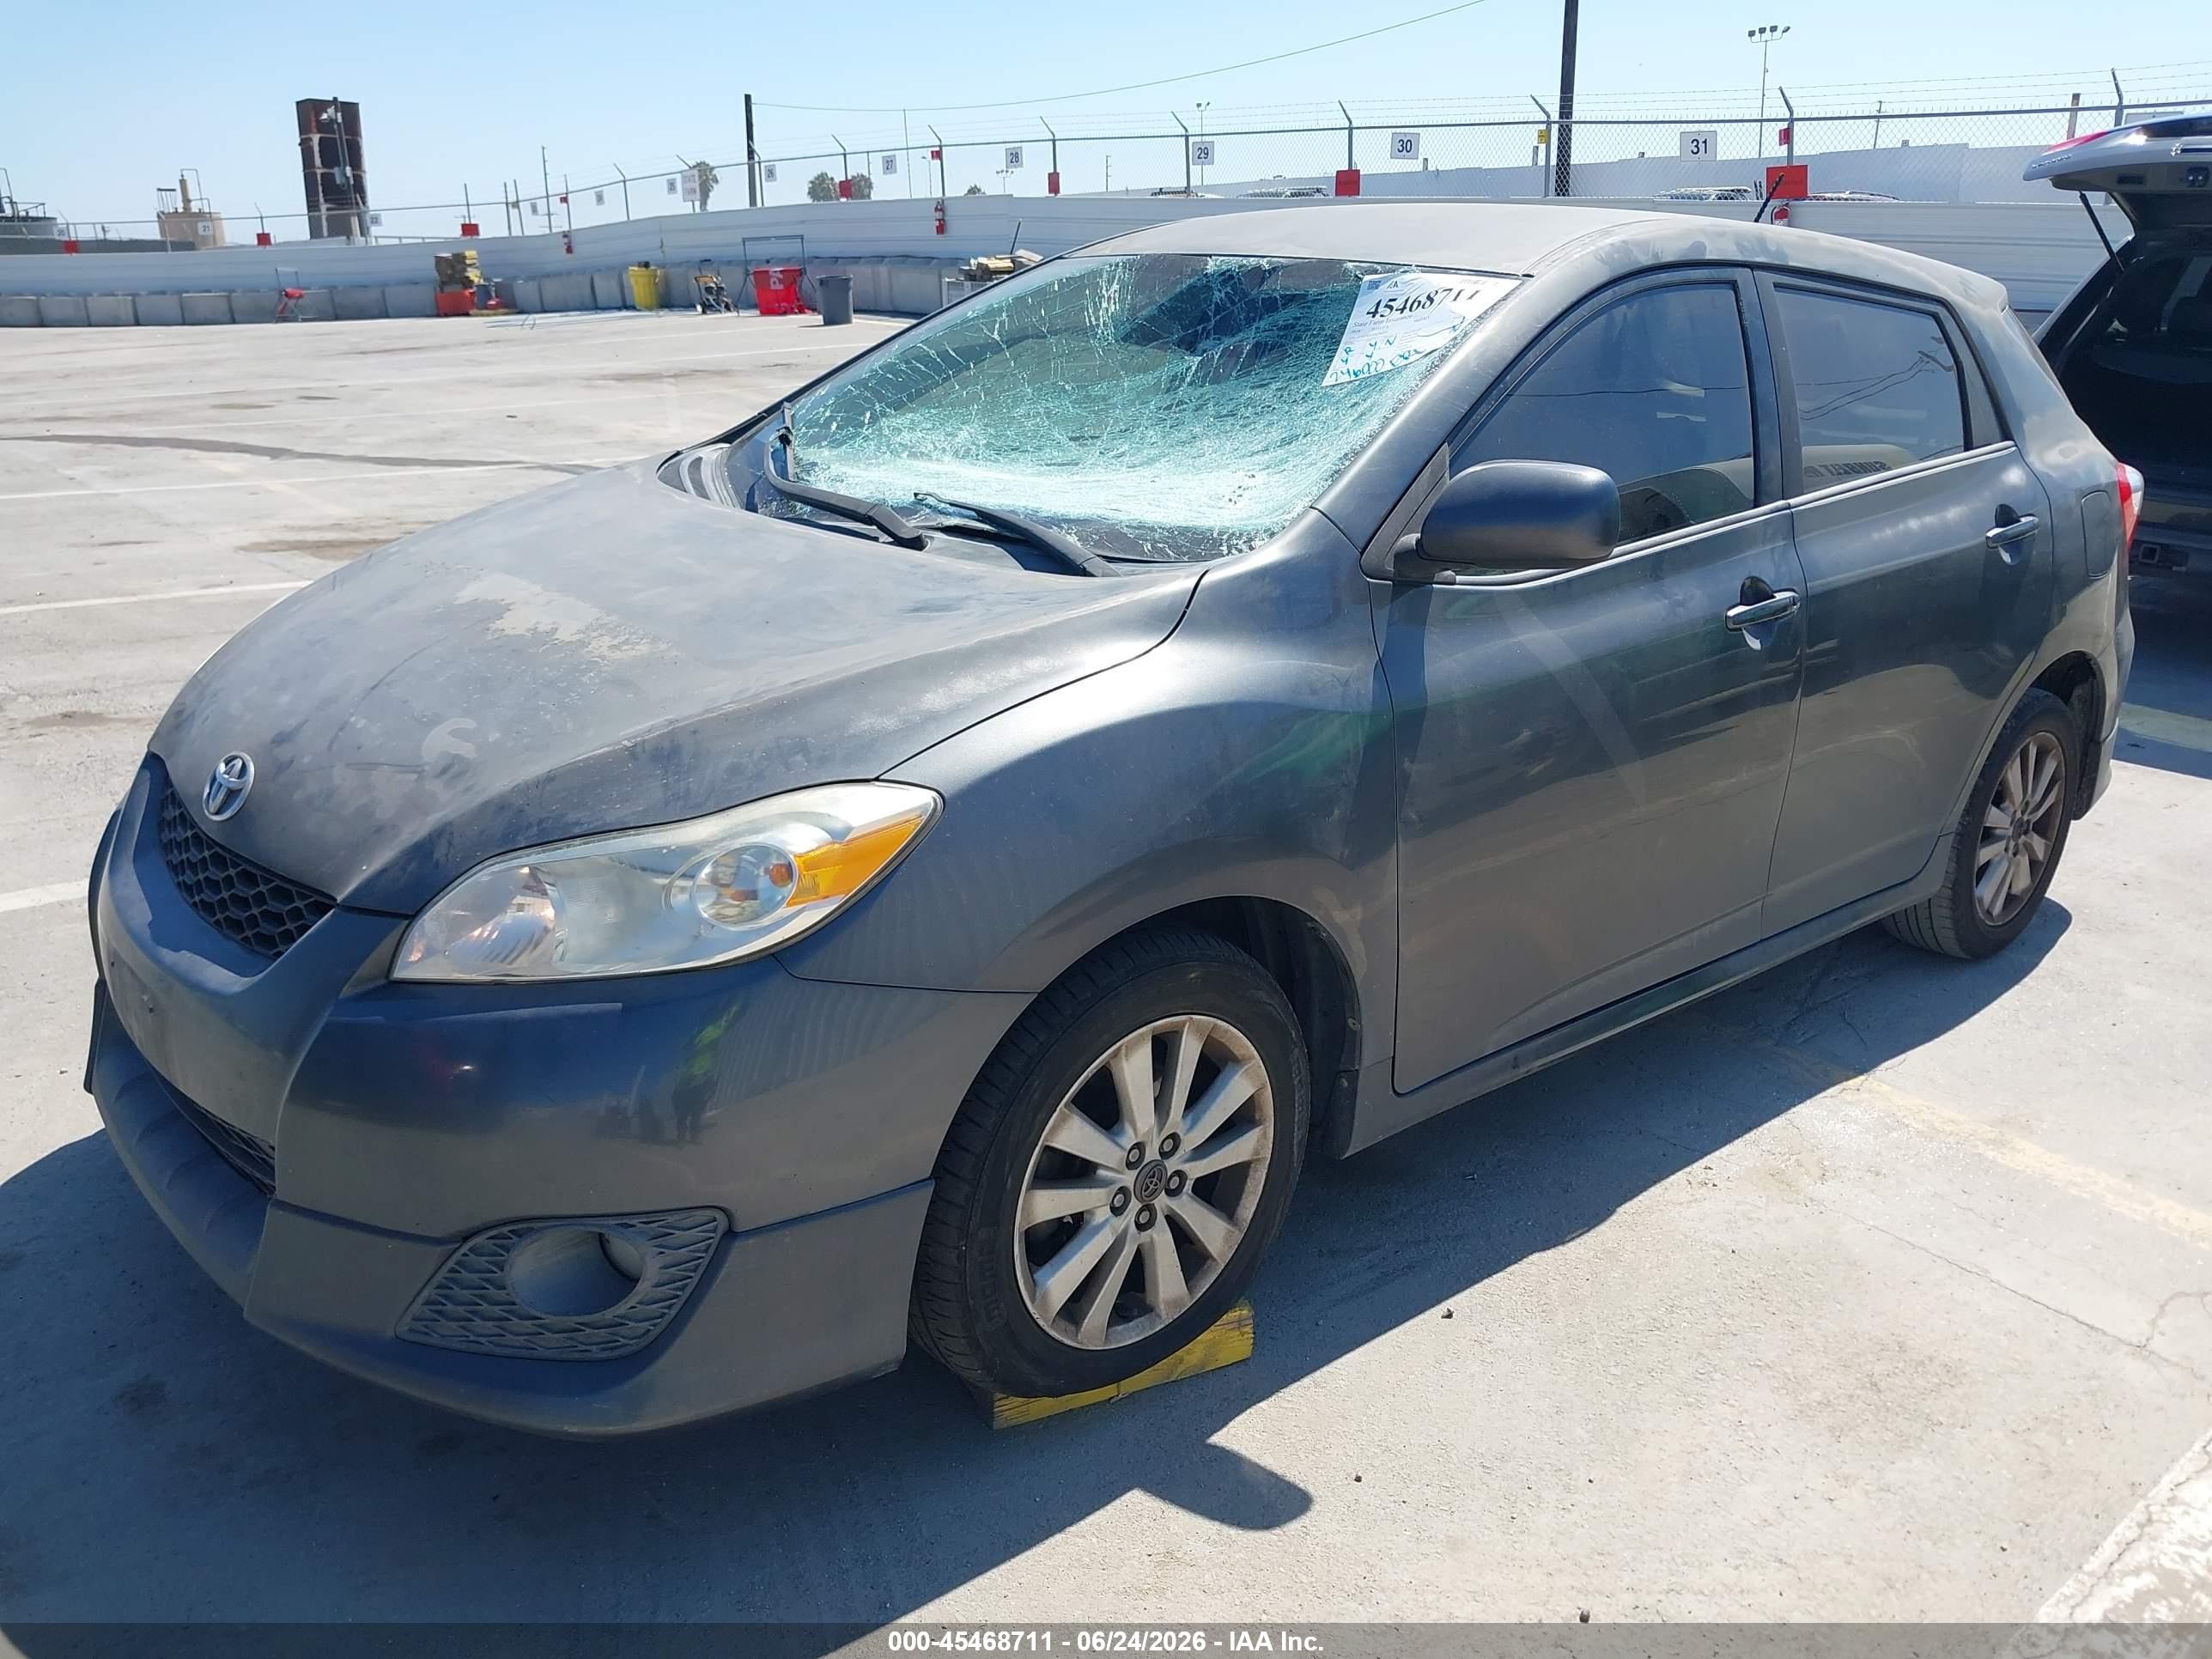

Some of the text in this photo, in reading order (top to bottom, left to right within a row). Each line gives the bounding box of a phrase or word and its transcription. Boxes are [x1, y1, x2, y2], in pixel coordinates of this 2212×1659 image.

[1196, 146, 1210, 160] 29
[1396, 138, 1413, 154] 30
[1690, 137, 1709, 155] 31
[885, 160, 895, 170] 27
[1009, 151, 1020, 164] 28
[1366, 288, 1481, 319] 45468711
